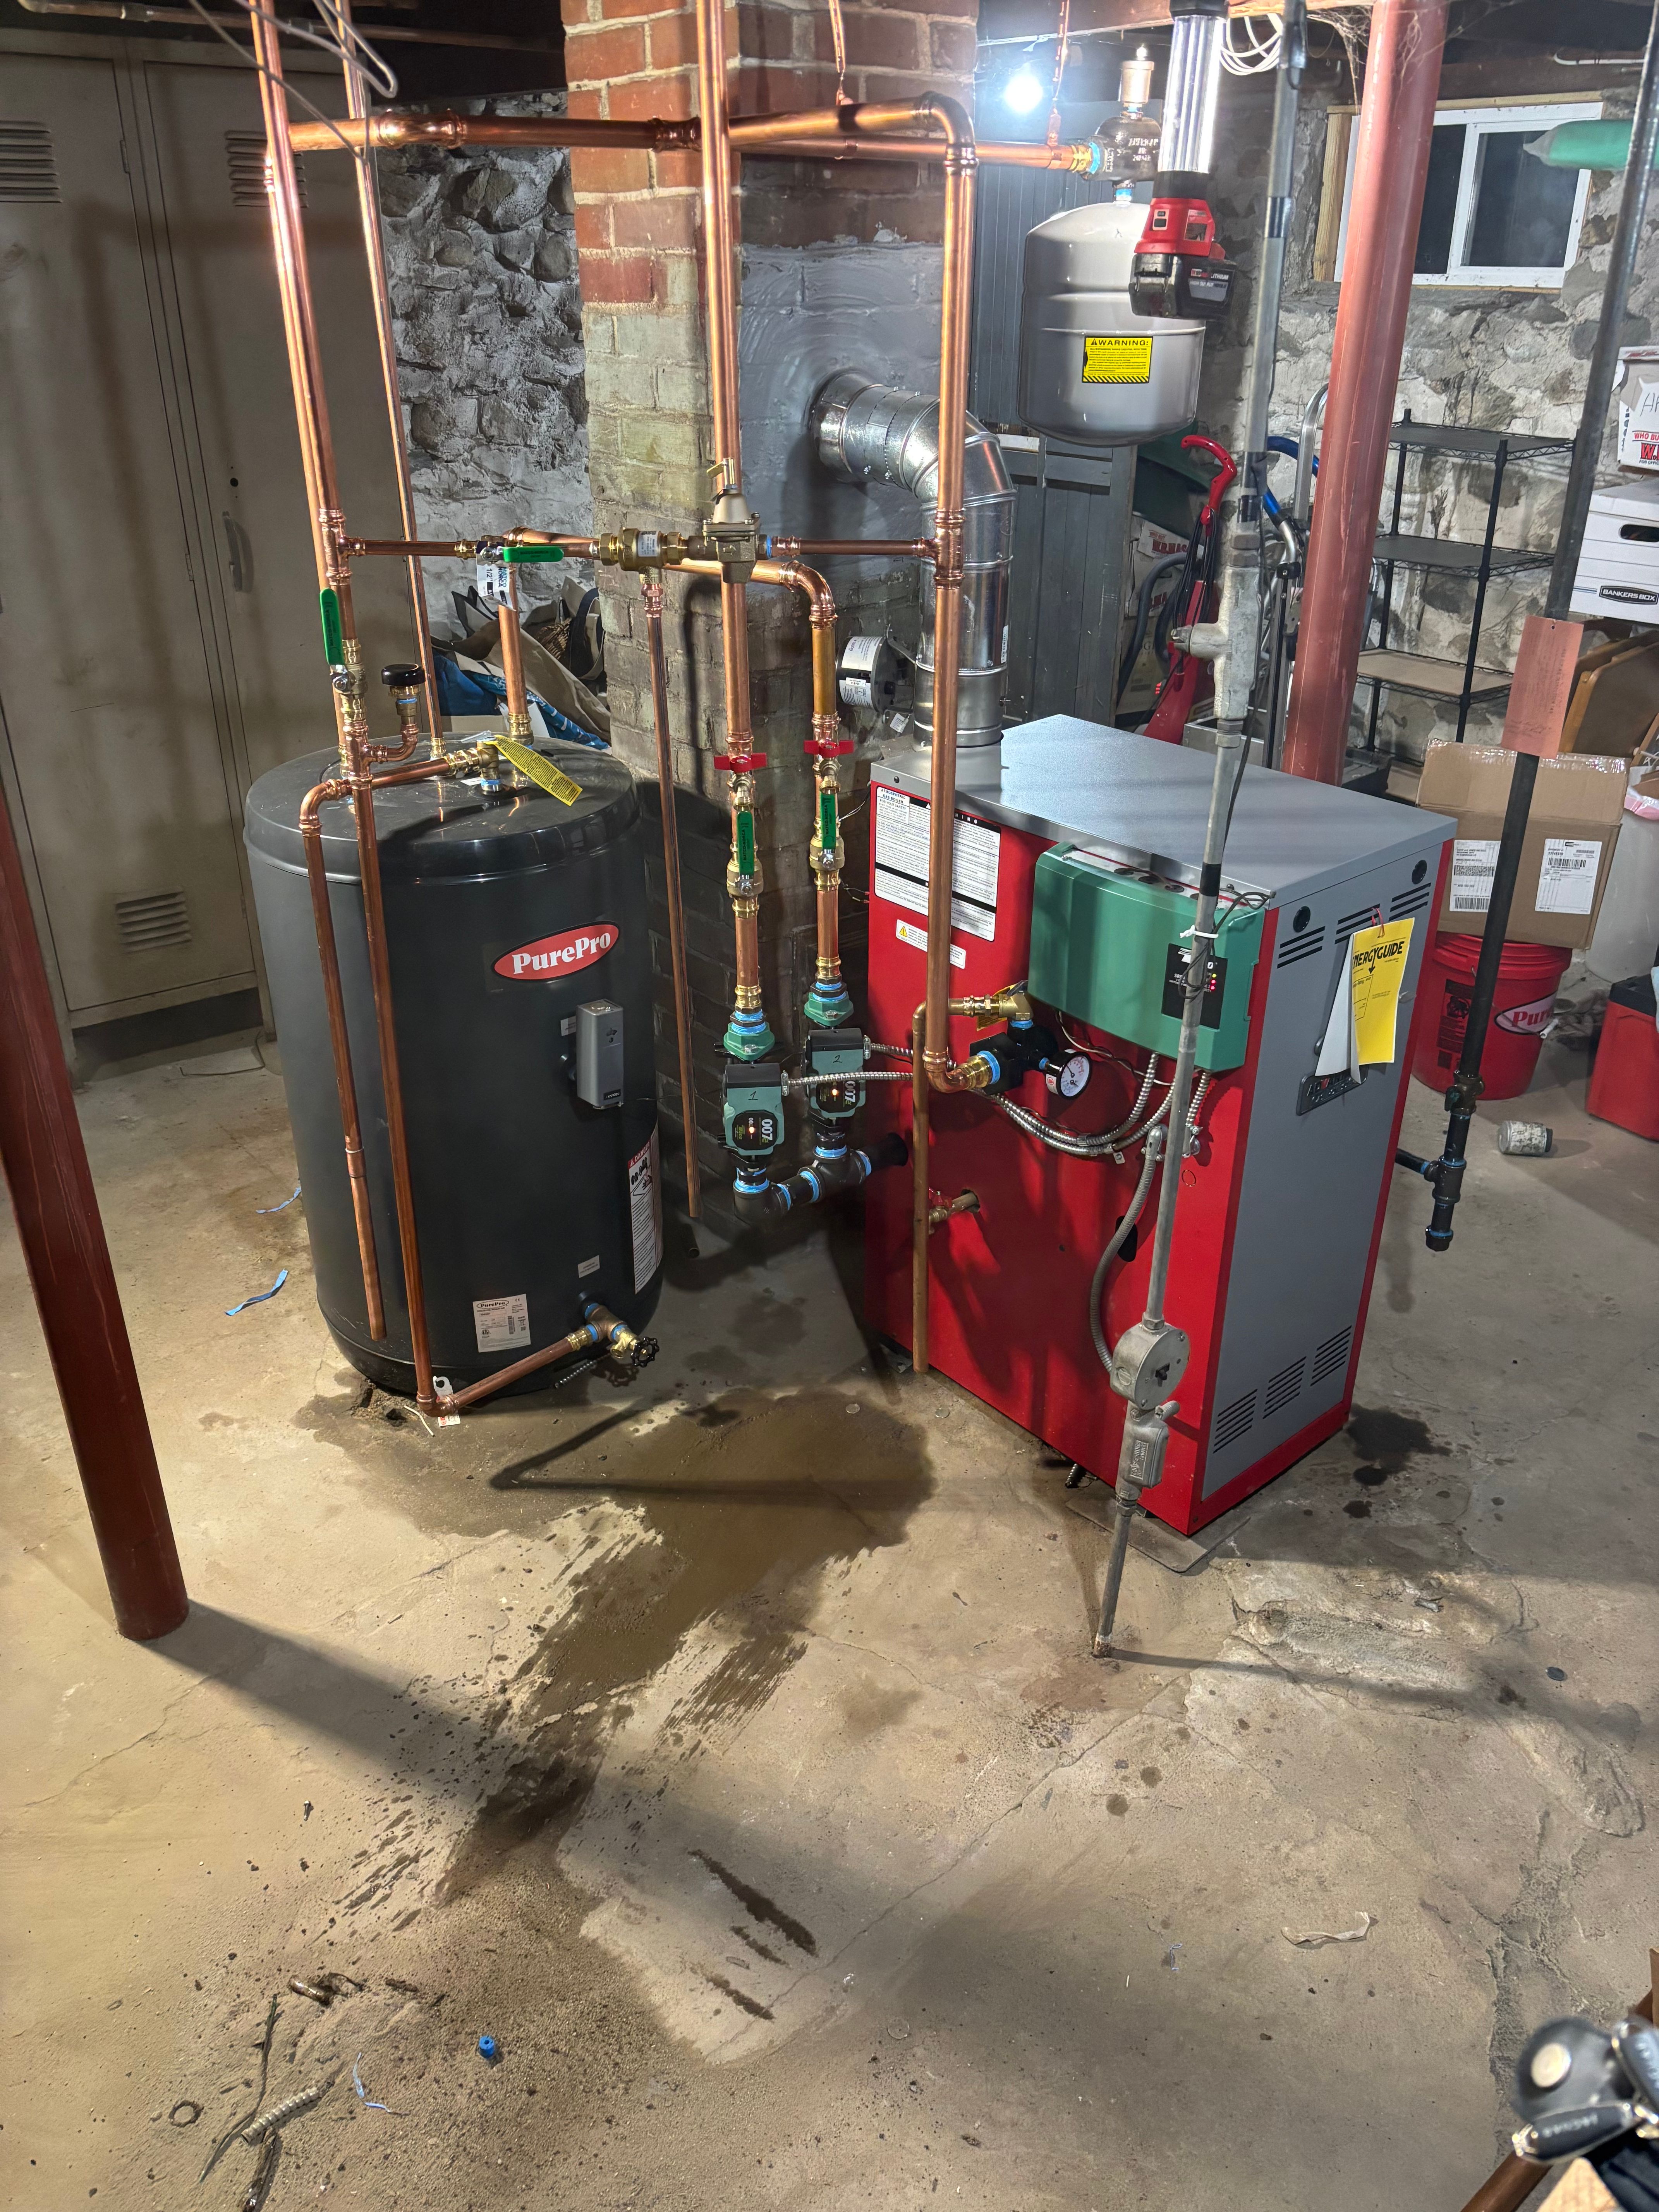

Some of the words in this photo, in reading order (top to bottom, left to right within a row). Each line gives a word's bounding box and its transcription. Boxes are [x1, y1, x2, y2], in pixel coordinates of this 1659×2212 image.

[1603, 589, 1638, 599] BANKERS
[512, 933, 611, 975] PurePro
[1353, 941, 1405, 974] NERGYGUIDE
[833, 1054, 843, 1063] 2
[748, 1091, 758, 1100] 1
[761, 1119, 773, 1143] 007e
[635, 1141, 650, 1161] DANGER
